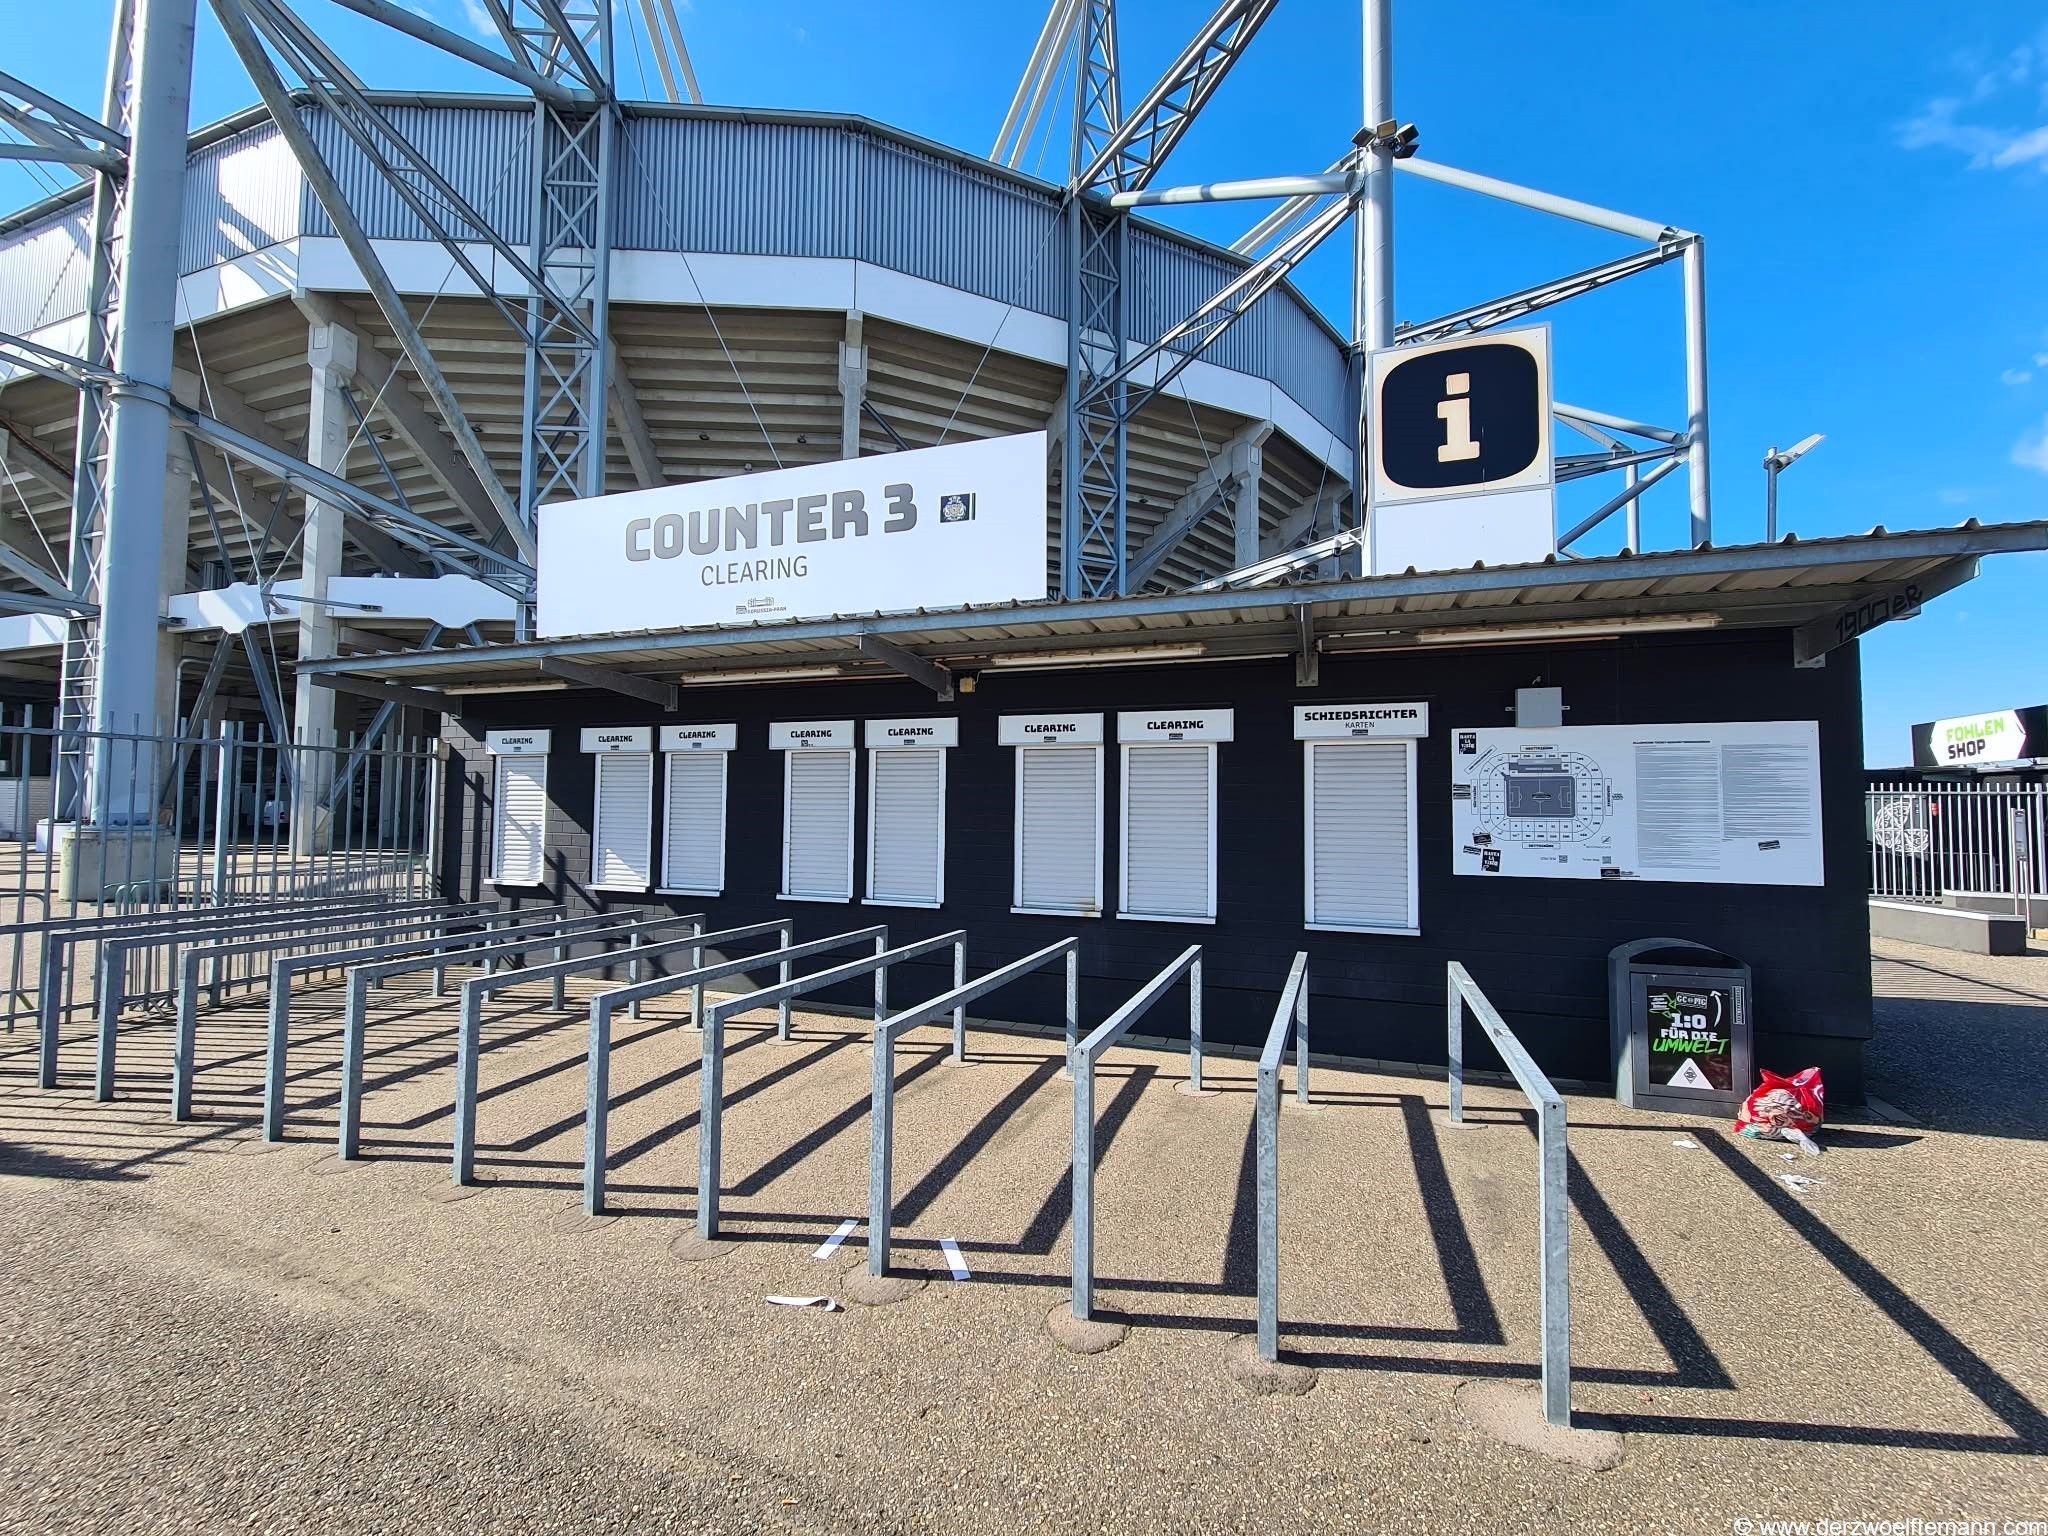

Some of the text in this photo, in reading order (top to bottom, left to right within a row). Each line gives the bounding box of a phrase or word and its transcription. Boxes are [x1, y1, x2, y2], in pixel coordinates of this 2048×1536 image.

[625, 482, 918, 562] COUNTER 3
[701, 555, 808, 586] CLEARING
[1304, 709, 1418, 721] SCHIEDSRICHTER
[1024, 724, 1076, 733] CLEARING
[1147, 720, 1204, 730] CLEARING
[1946, 717, 2005, 742] FOHLEN
[678, 731, 716, 739] CLEARING
[790, 730, 832, 738] CLEARING
[888, 728, 933, 736] CLEARING
[501, 737, 533, 745] CLEARING
[598, 735, 633, 743] CLEARING
[1948, 739, 1986, 760] SHOP
[1671, 1012, 1707, 1029] 1:0
[1660, 1027, 1718, 1042] FÜR DIE
[1653, 1038, 1730, 1055] UMWELT
